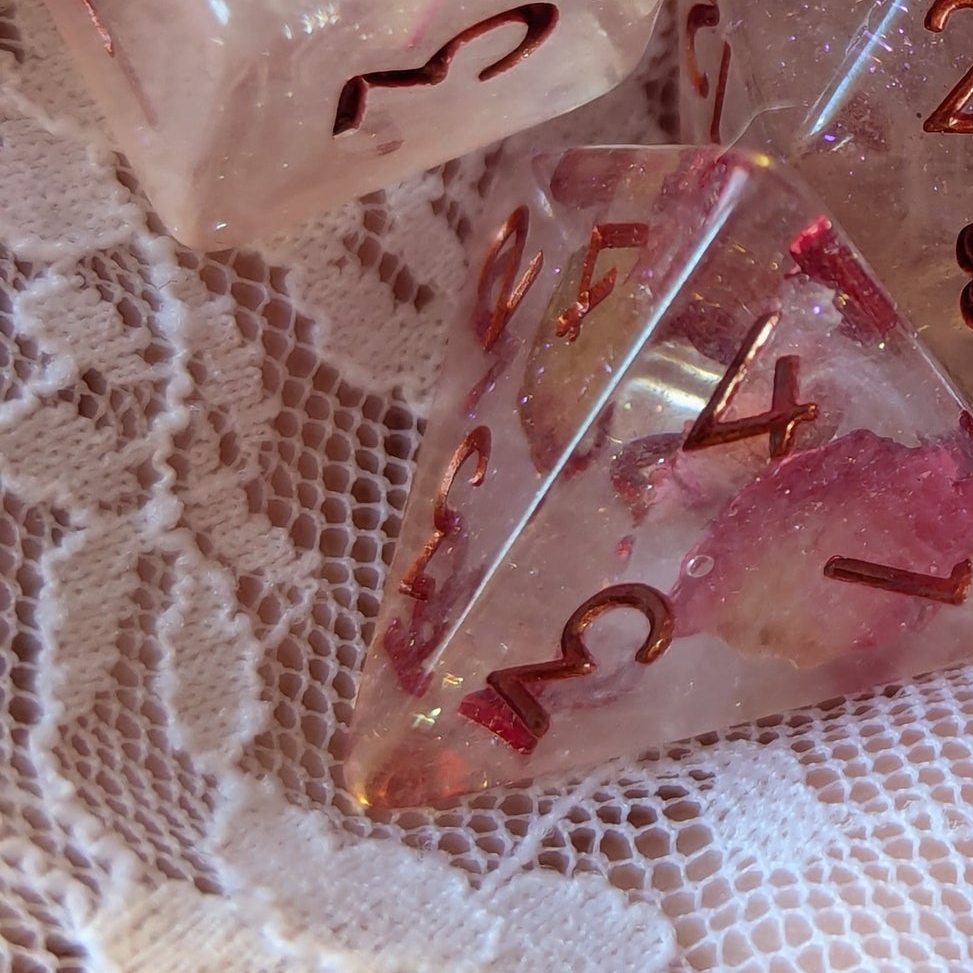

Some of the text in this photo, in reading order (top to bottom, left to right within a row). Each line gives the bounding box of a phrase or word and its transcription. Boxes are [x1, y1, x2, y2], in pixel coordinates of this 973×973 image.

[332, 1, 561, 137] 3
[681, 311, 821, 459] 4
[486, 582, 676, 743] 3
